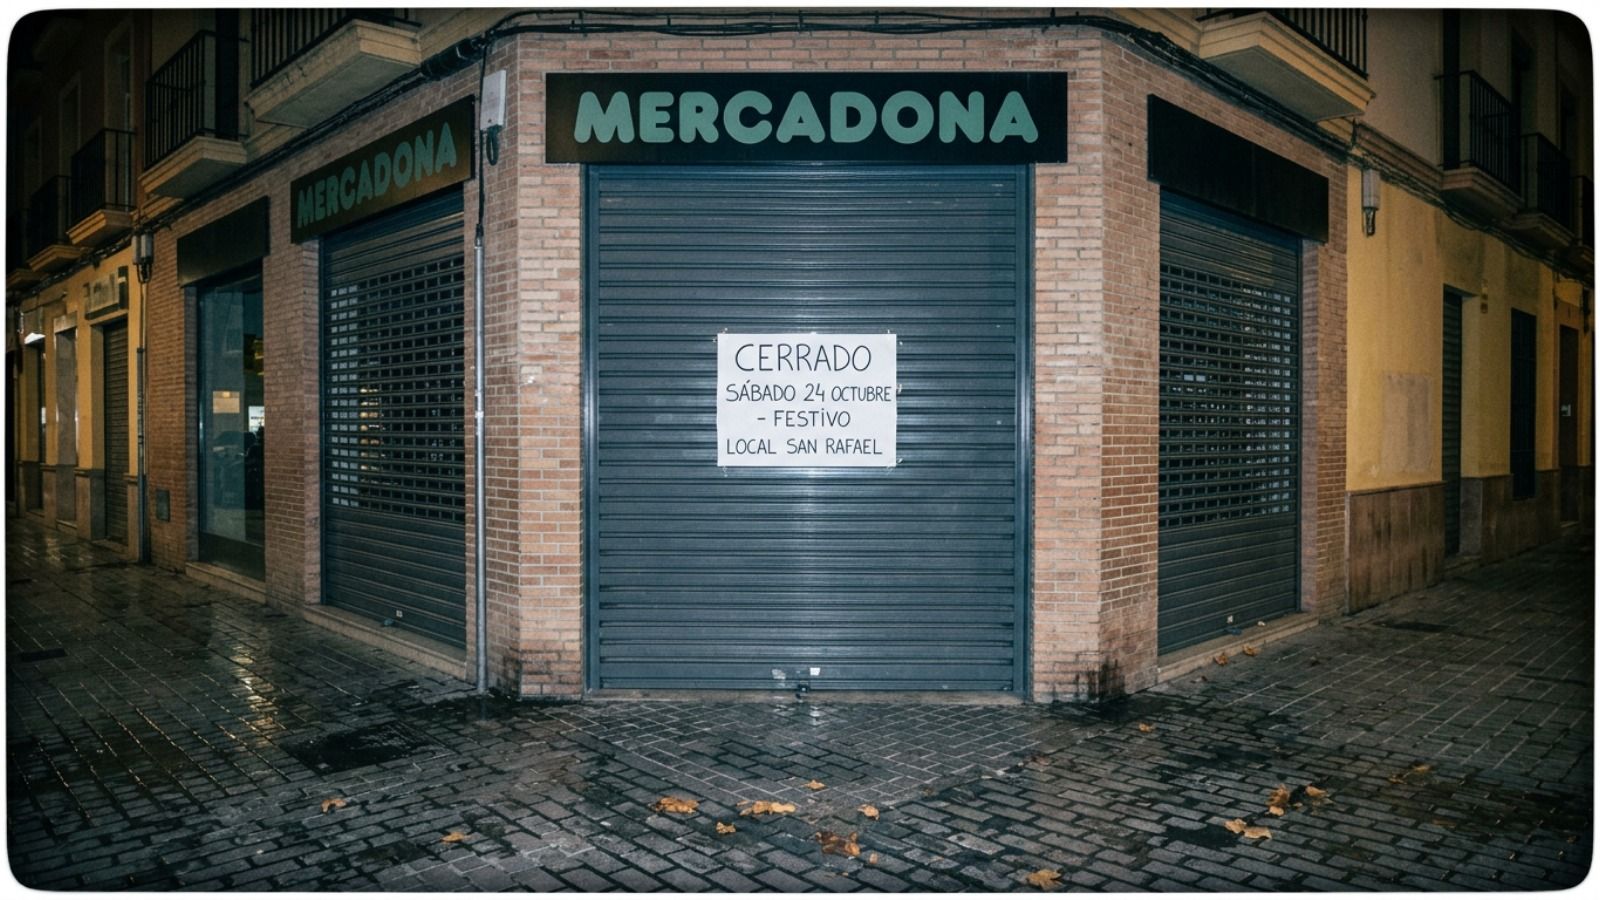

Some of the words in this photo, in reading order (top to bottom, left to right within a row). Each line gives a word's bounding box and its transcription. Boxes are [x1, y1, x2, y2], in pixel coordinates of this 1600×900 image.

[574, 90, 1038, 143] MERCADONA
[297, 122, 457, 228] MERCADONA
[735, 343, 872, 372] CERRADO
[725, 379, 796, 402] SÁBADO
[803, 383, 825, 402] 24
[831, 386, 892, 402] OCTUBRE
[726, 439, 777, 454] LOCAL
[786, 438, 817, 454] SAN
[826, 438, 883, 455] RAFAEL
